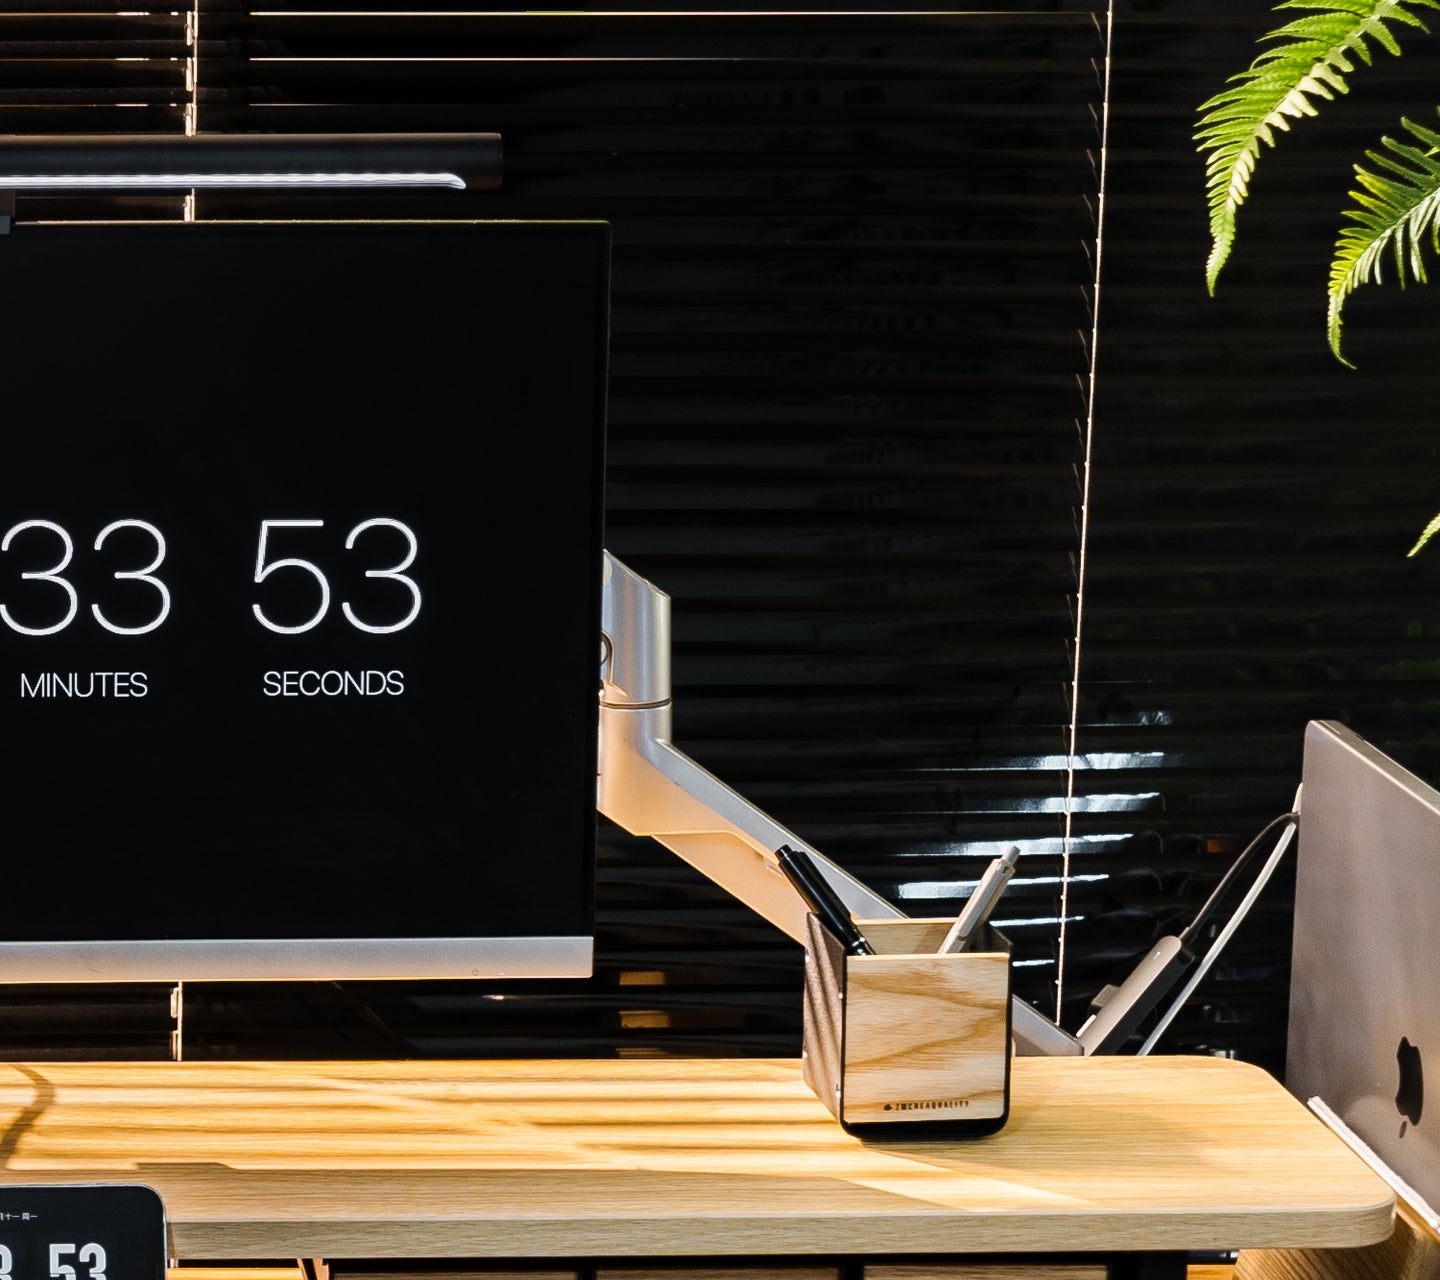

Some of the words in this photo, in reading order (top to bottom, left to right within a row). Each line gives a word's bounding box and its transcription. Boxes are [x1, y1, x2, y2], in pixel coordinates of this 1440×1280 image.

[251, 517, 422, 635] 53
[20, 671, 148, 698] MINUTES
[263, 669, 405, 697] SECONDS
